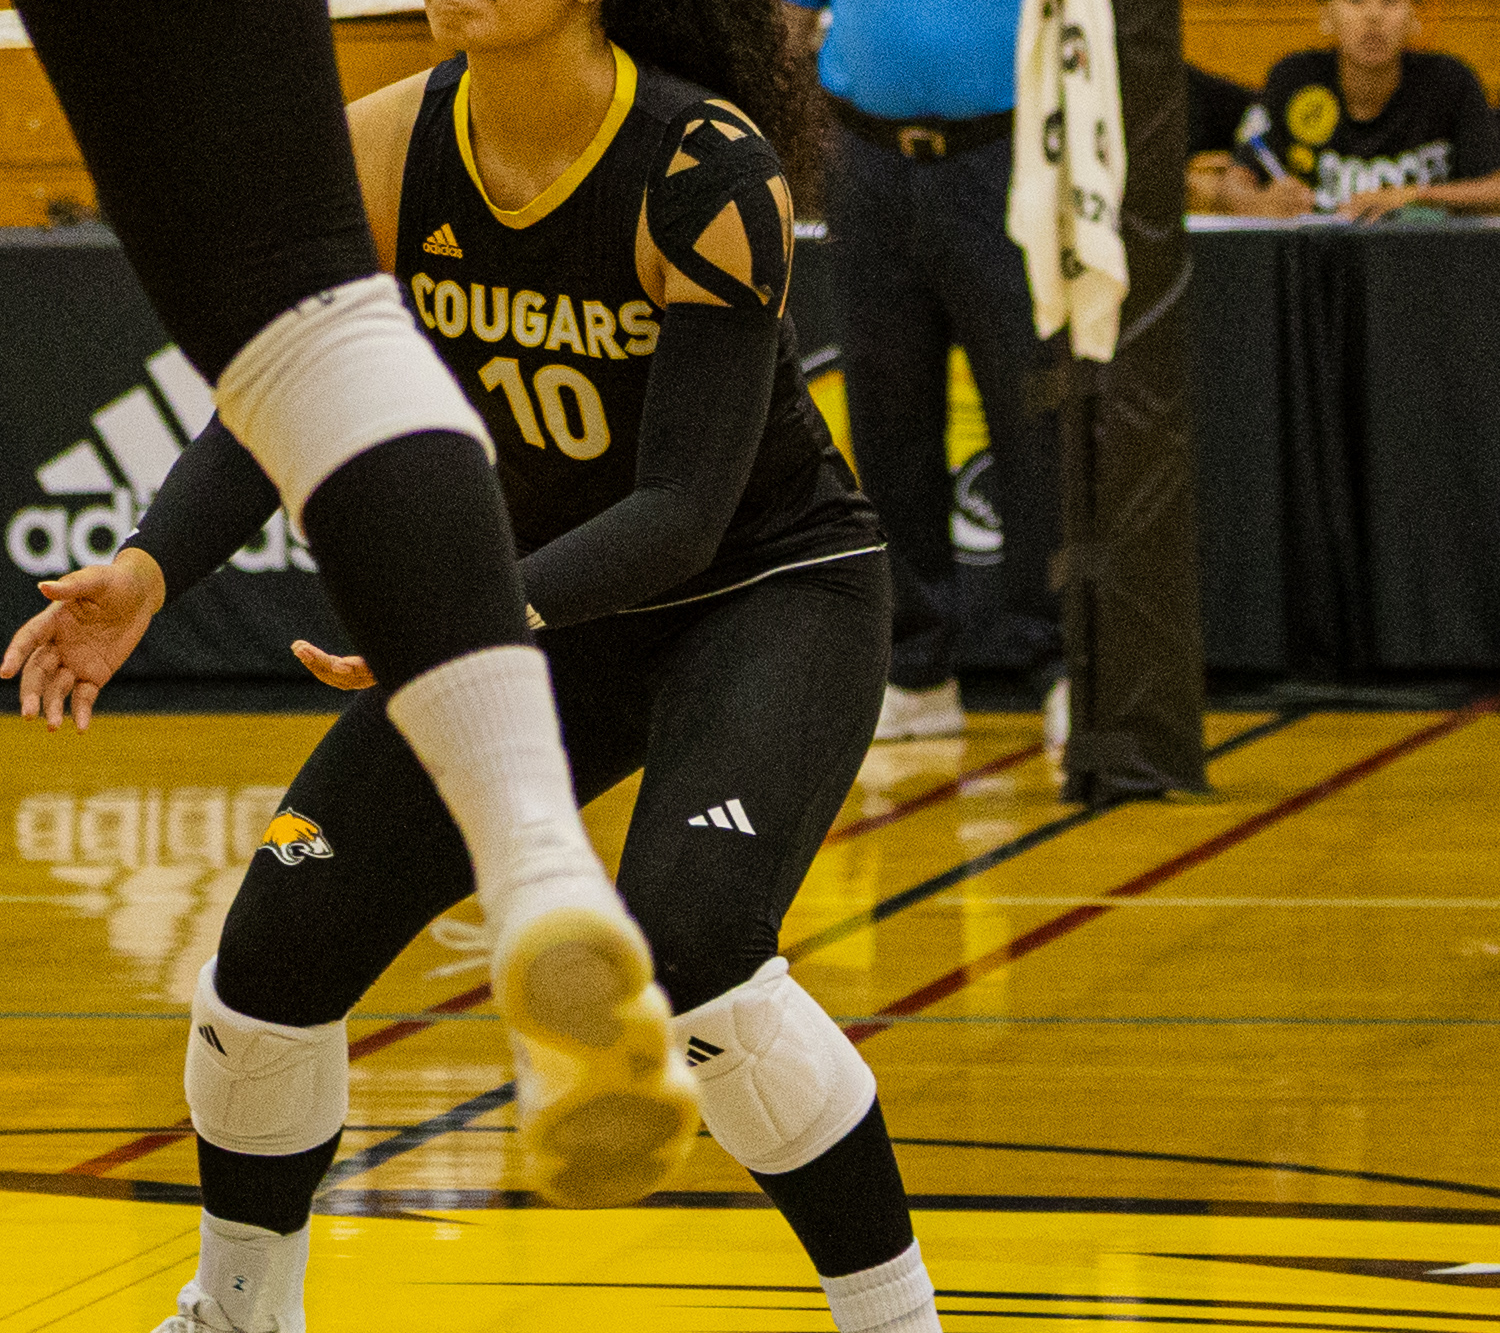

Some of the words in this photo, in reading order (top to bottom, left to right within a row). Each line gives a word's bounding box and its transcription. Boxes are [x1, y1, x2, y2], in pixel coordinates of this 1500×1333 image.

[422, 242, 464, 260] adidas
[411, 272, 662, 361] COUGARS
[477, 355, 612, 461] 10
